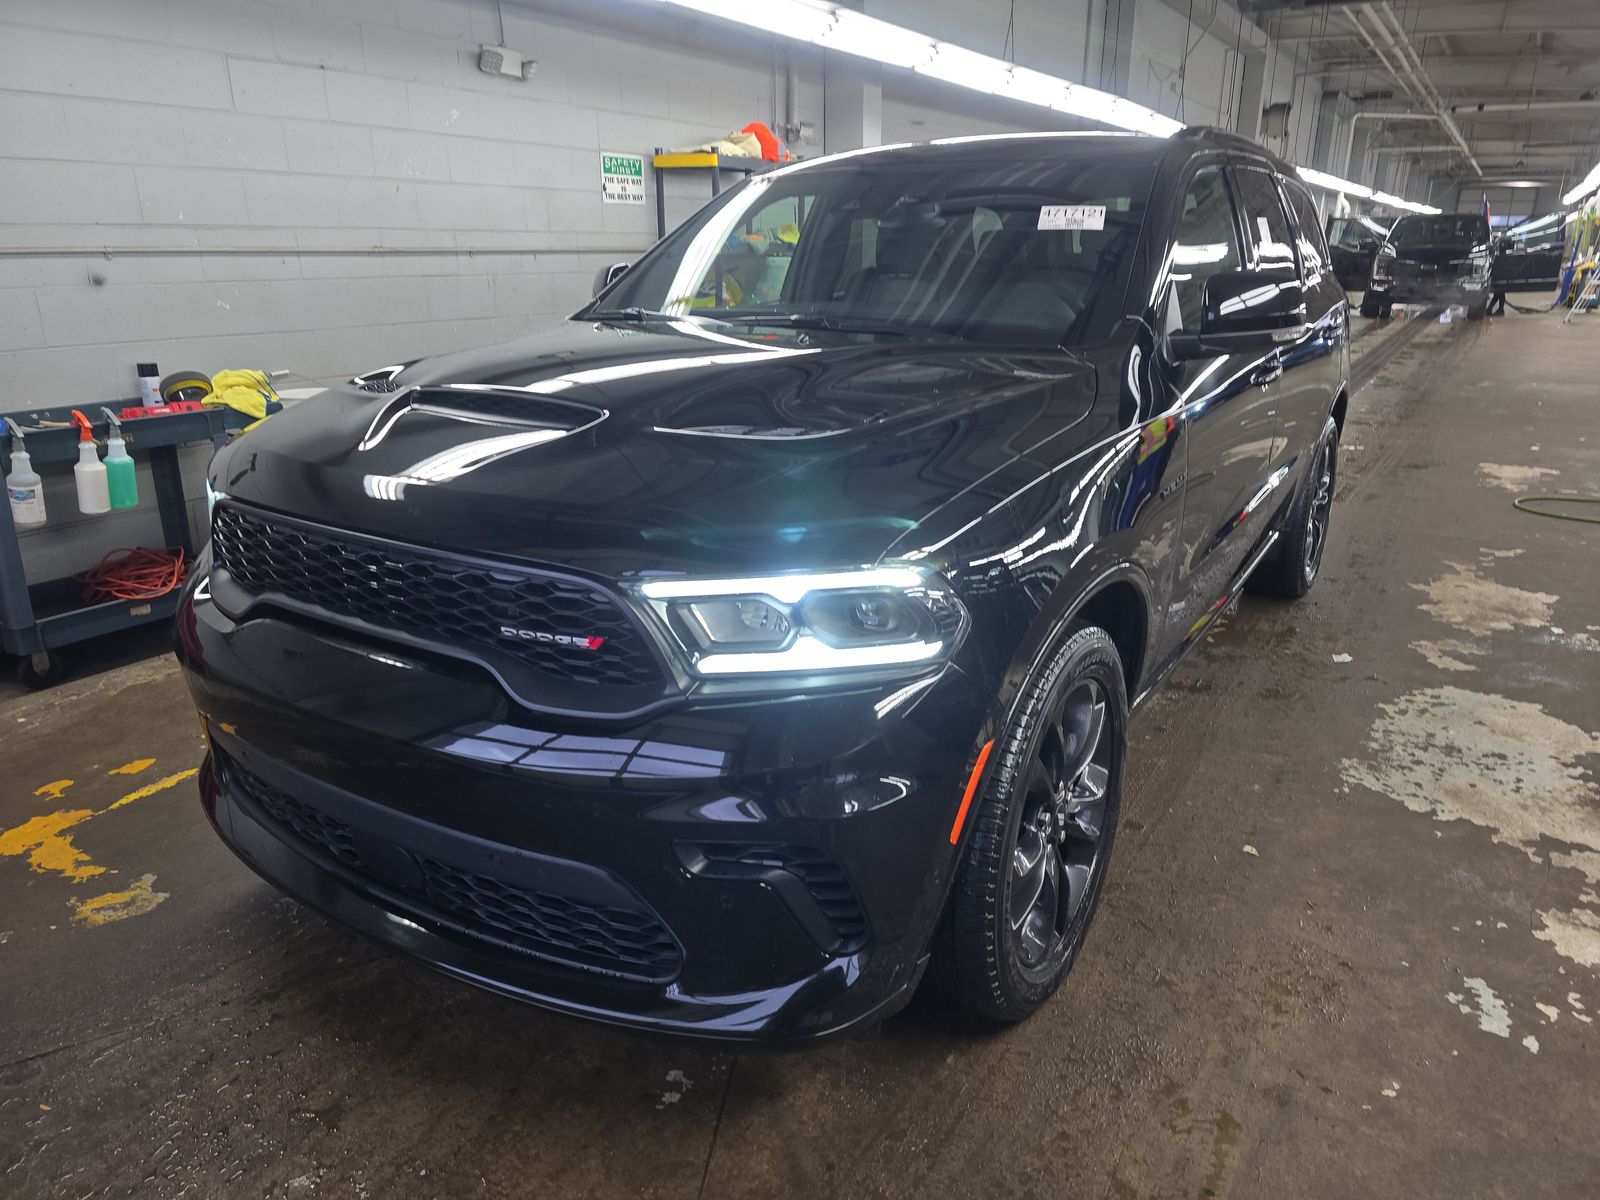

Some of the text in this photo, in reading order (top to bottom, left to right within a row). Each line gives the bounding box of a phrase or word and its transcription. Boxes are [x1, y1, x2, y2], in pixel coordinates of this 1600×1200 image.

[604, 157, 640, 170] SAFETY
[611, 165, 635, 175] FIRST
[631, 178, 642, 186] WAY
[605, 192, 616, 200] THE
[632, 194, 643, 202] WAY
[500, 626, 590, 648] DODGE
